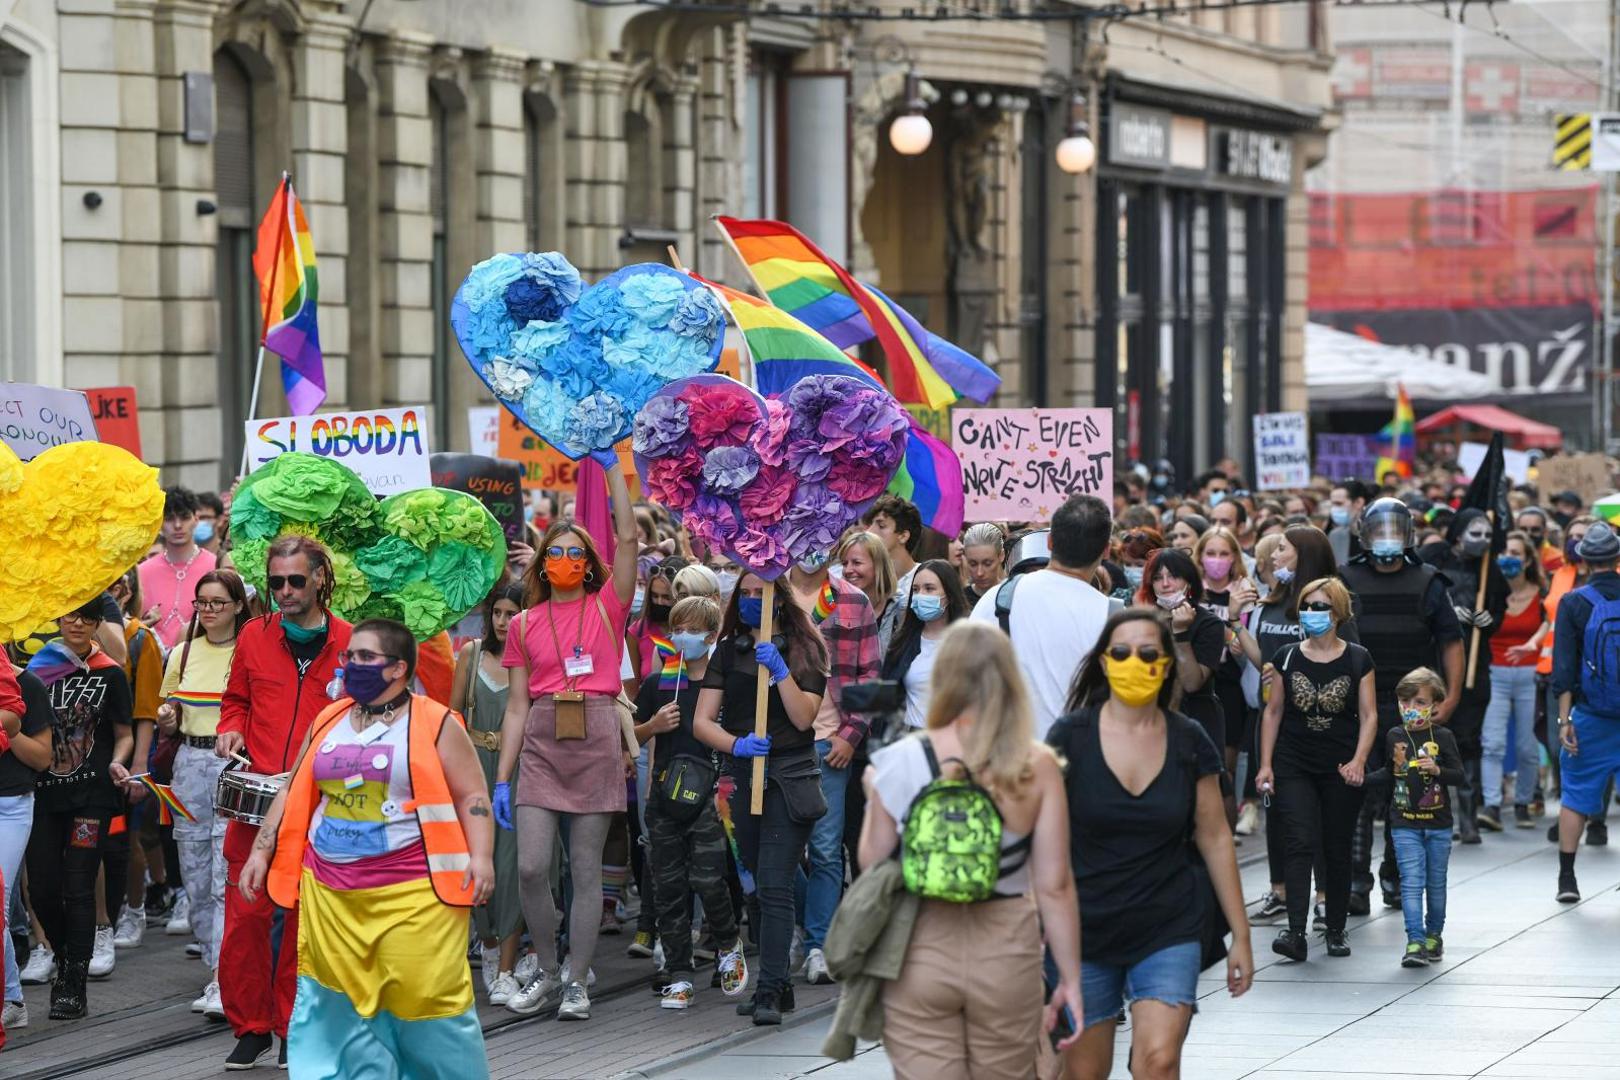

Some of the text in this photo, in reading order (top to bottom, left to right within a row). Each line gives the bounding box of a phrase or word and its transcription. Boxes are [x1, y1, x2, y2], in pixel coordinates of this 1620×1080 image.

[40, 407, 84, 441] OUR
[257, 410, 422, 462] SLOBODA
[1039, 415, 1100, 448] EVEN
[468, 476, 515, 496] USING
[492, 502, 515, 518] TO
[49, 676, 107, 710] ISS
[333, 793, 367, 809] NOT
[683, 789, 697, 801] CAT
